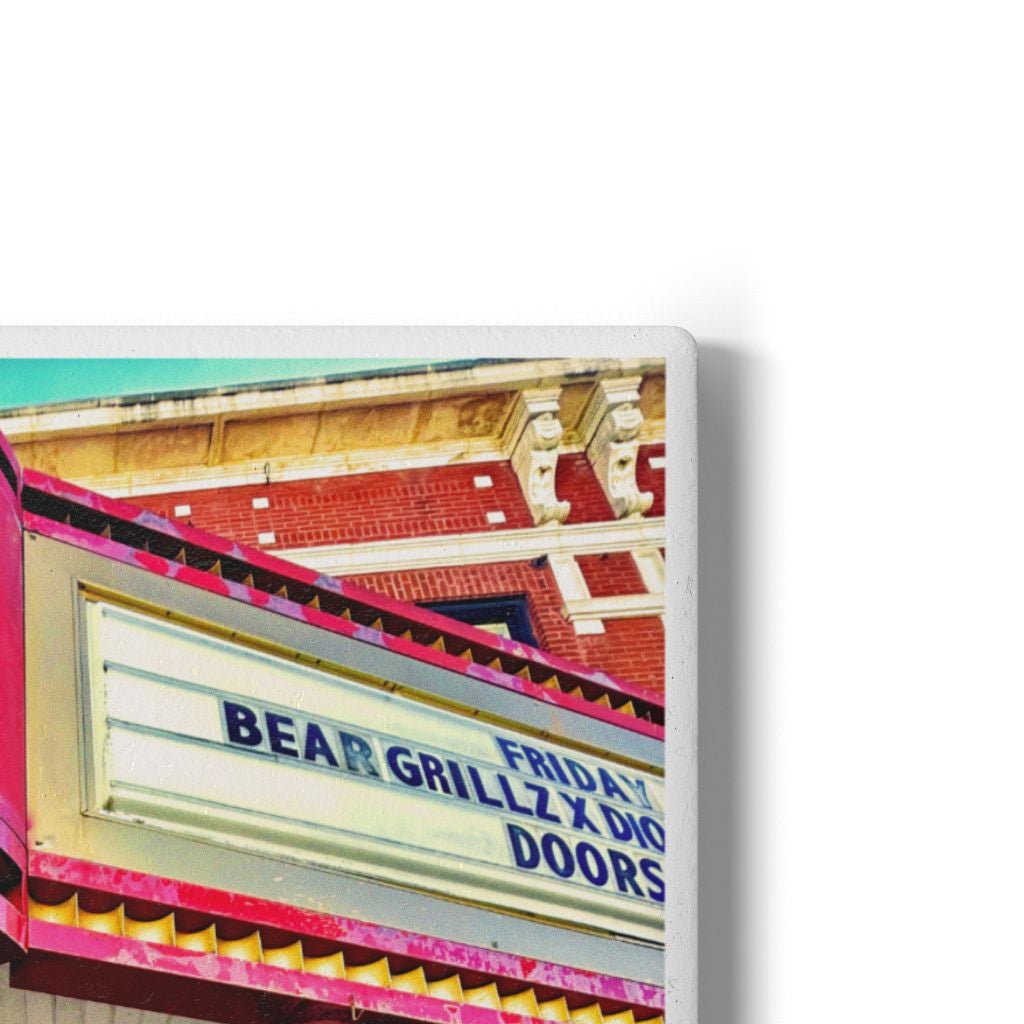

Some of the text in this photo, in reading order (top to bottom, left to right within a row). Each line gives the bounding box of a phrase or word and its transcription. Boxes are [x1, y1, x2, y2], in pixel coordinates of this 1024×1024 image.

[223, 701, 379, 778] BEAR
[386, 745, 561, 824] GRILLZ
[561, 795, 602, 835] X
[496, 735, 652, 809] FRIDAY
[506, 822, 665, 903] DOORS
